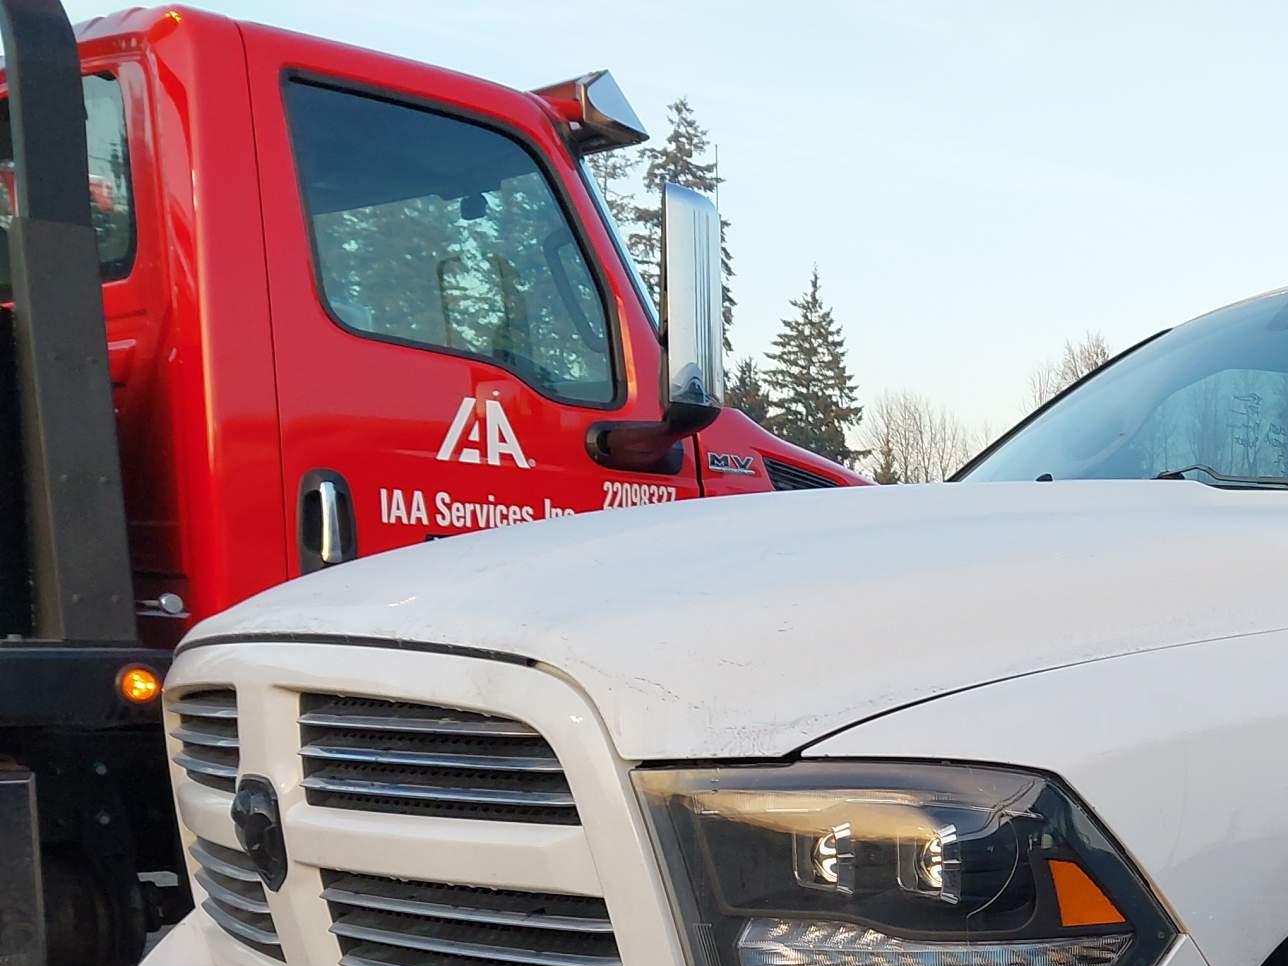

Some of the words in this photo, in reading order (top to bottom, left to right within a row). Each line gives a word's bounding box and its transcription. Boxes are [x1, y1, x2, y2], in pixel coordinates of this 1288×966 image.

[707, 452, 753, 471] MV
[380, 488, 429, 526] IAA
[435, 492, 535, 529] Services
